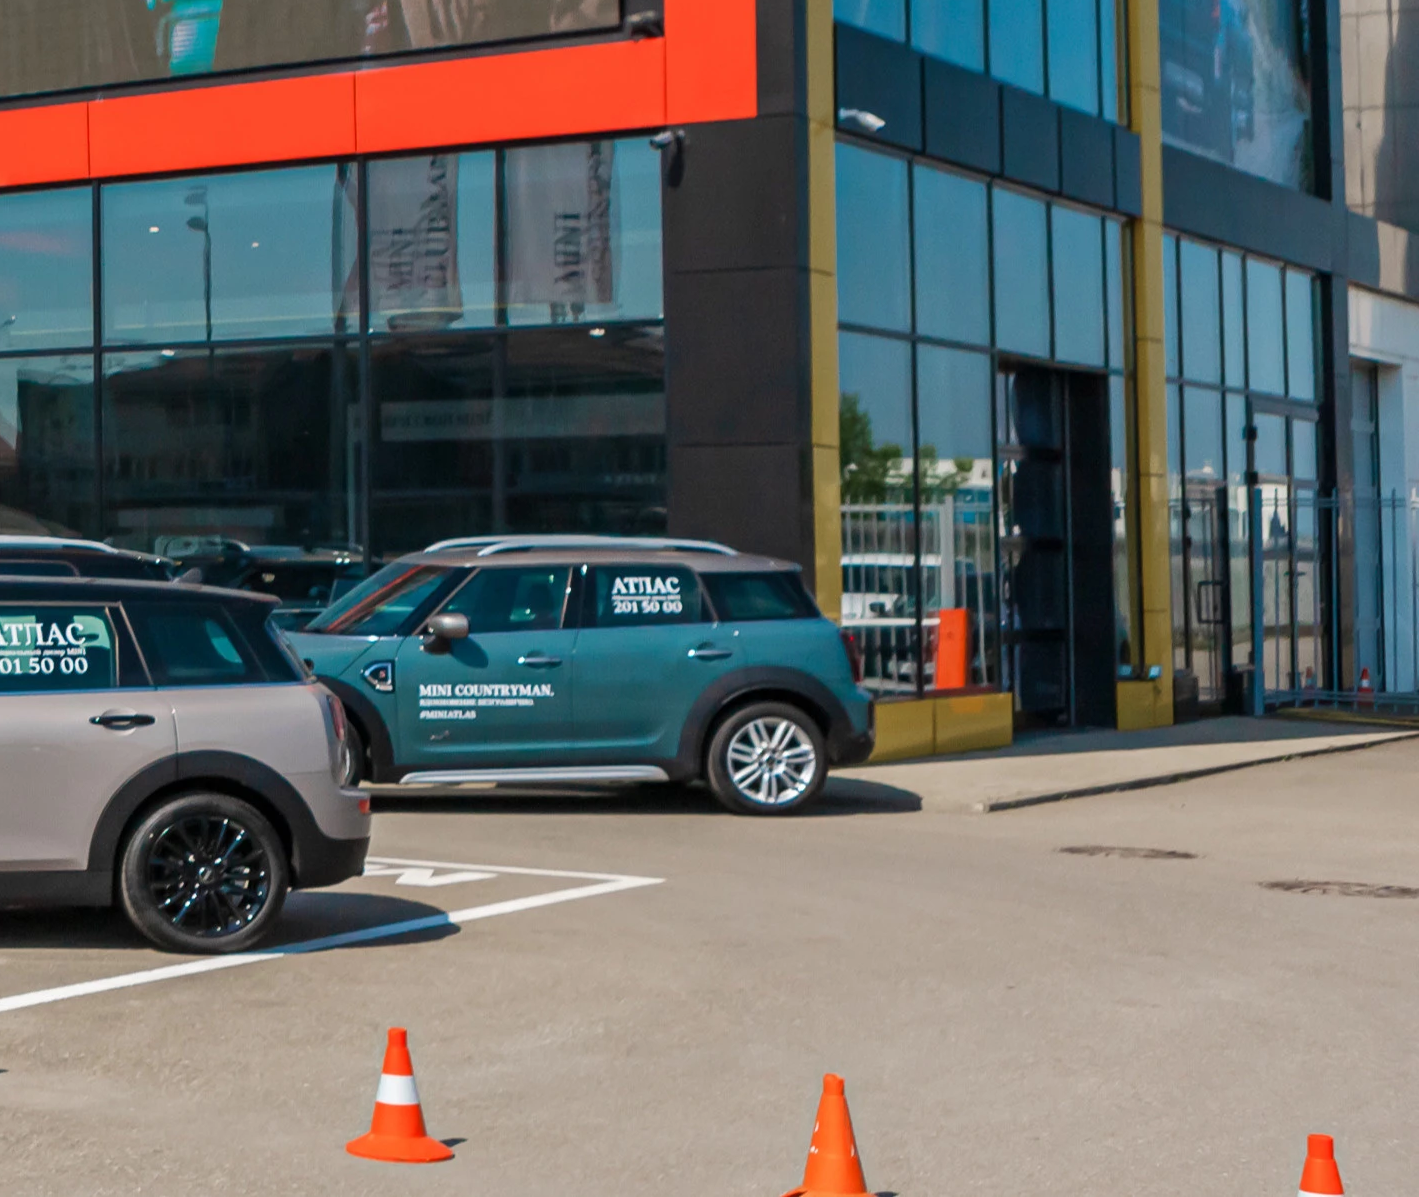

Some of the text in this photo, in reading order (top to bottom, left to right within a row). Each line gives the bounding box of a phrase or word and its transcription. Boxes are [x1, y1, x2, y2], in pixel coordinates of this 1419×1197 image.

[612, 576, 681, 595] АТЛАС
[613, 600, 683, 614] 201 50 00
[28, 657, 55, 674] 50
[60, 657, 89, 674] 00
[419, 684, 452, 697] MINI
